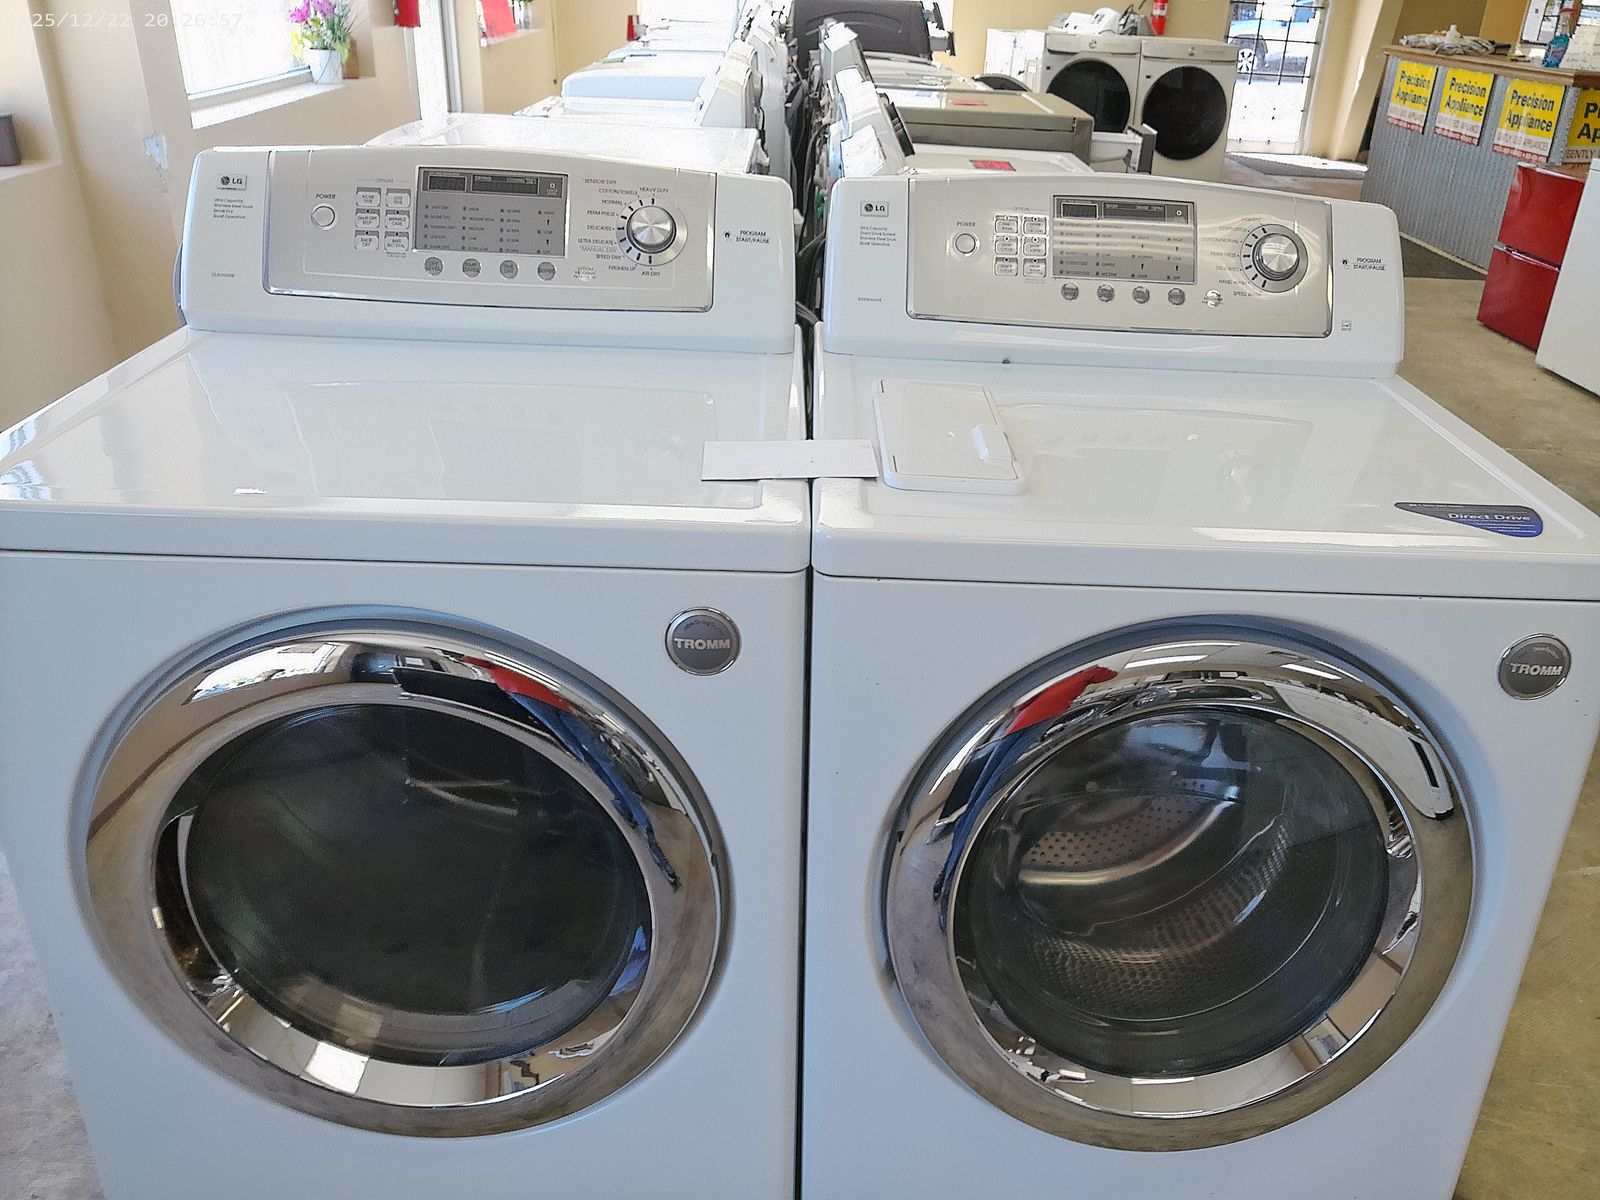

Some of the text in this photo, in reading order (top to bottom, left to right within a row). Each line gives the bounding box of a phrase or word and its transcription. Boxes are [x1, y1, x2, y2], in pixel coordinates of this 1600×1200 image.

[1400, 70, 1430, 90] Precision
[1449, 77, 1486, 97] Precision
[1396, 85, 1428, 106] Appliance
[1445, 95, 1483, 116] Appliance
[1511, 89, 1554, 111] Precision
[674, 637, 731, 650] TROMM
[1510, 662, 1563, 676] TROMM
